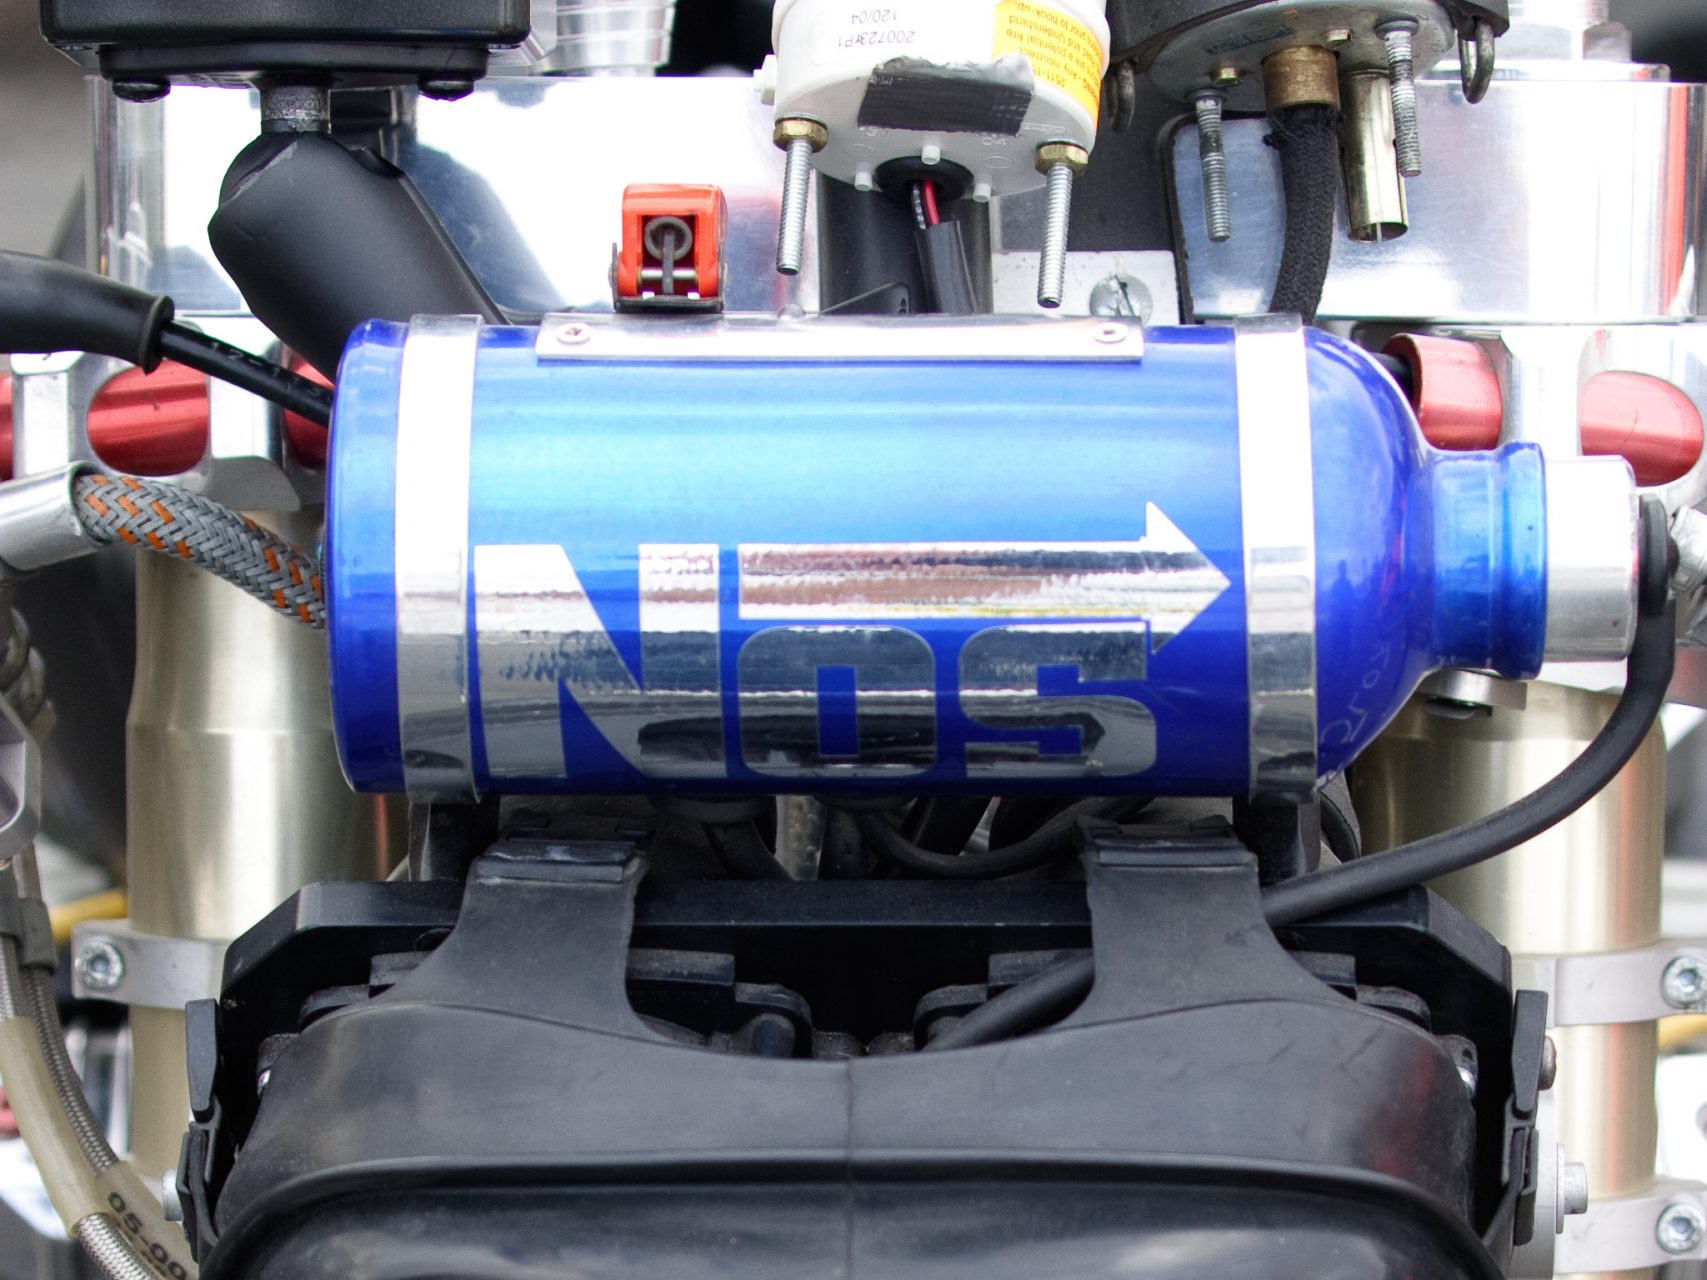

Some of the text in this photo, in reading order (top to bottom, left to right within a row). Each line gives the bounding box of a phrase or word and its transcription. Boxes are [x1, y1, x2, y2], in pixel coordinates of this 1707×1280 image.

[1008, 15, 1066, 45] Understand
[1027, 33, 1067, 57] potential
[1019, 47, 1061, 71] incorrect
[1063, 63, 1078, 81] Any
[474, 542, 1158, 780] NOS
